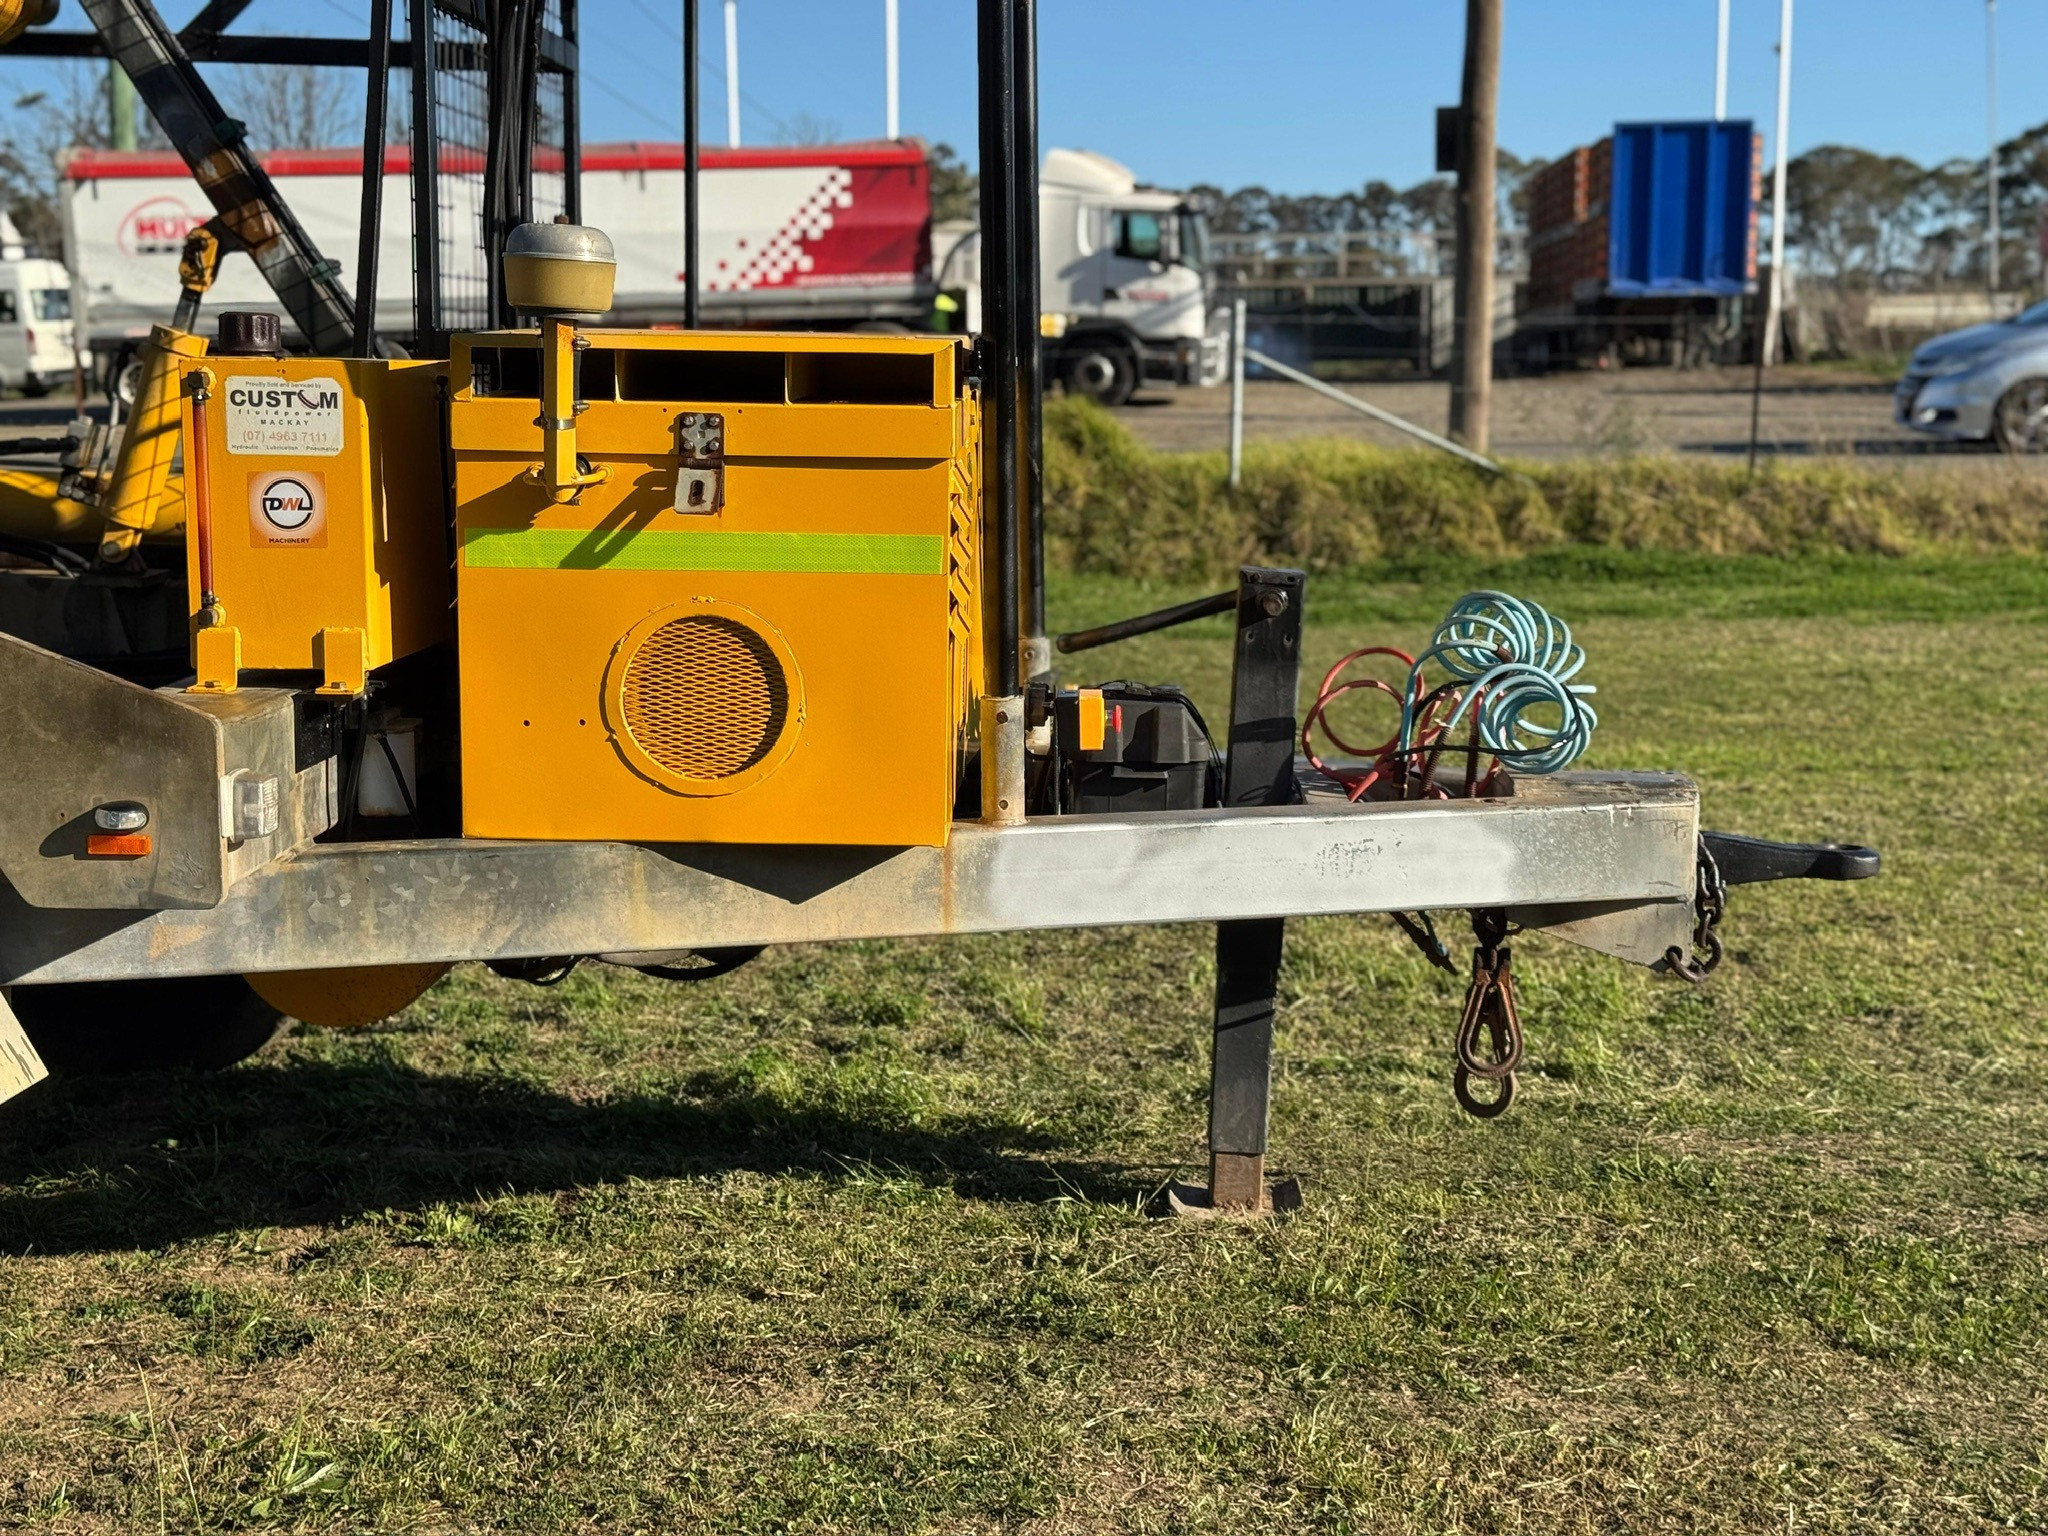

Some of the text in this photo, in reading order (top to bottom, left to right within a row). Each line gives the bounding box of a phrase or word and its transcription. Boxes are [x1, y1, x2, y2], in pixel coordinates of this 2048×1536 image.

[230, 389, 338, 410] CUSTOM
[260, 419, 310, 427] MACKAY
[243, 430, 328, 443] (07) 4963 7111
[262, 497, 313, 511] DWL
